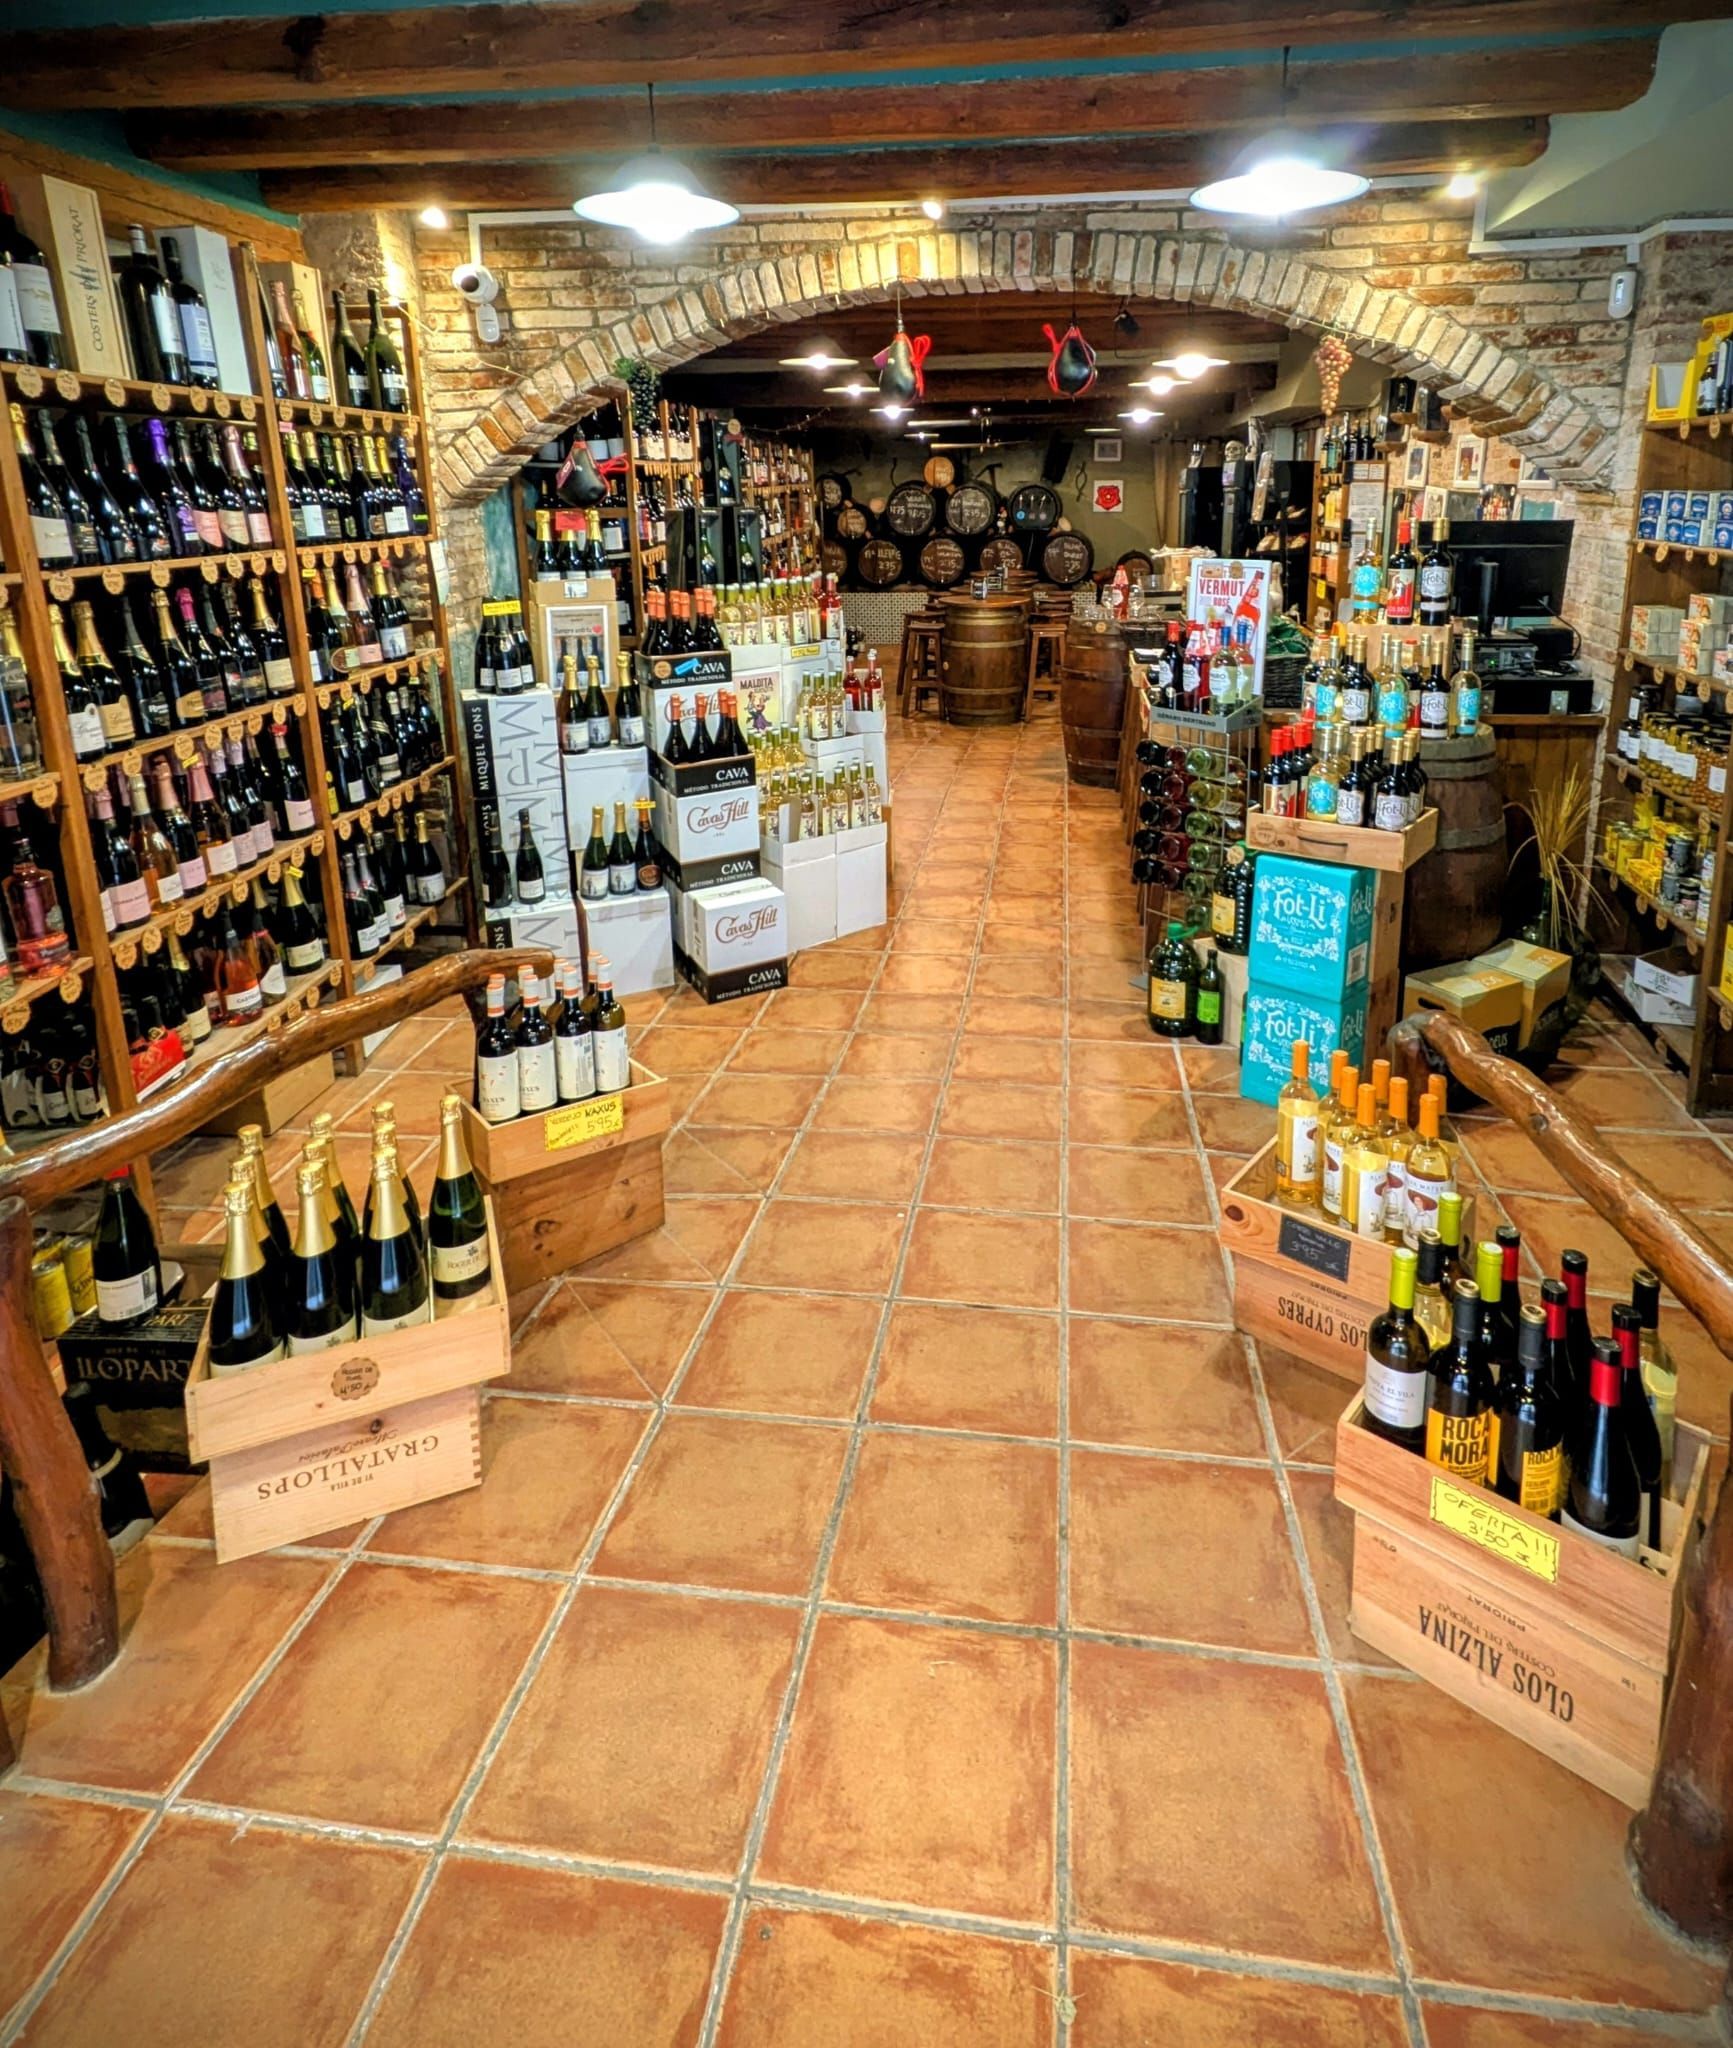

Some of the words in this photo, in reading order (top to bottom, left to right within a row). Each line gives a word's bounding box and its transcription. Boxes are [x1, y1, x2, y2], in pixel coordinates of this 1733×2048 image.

[69, 206, 88, 264] PRIORAT
[86, 293, 104, 352] COSTERS
[1199, 578, 1246, 597] VERMUT
[692, 661, 726, 675] CAVA
[740, 677, 774, 691] MALDITA
[472, 706, 483, 741] PONS
[474, 743, 490, 791] MIQUEL
[710, 778, 750, 790] TRADICIONAL
[715, 767, 749, 781] CAVA
[687, 805, 724, 835] Cavas
[722, 797, 750, 825] Hill
[721, 860, 754, 875] CAVA
[715, 913, 752, 945] Cavas
[749, 904, 779, 932] Hill
[1273, 887, 1327, 930] Fot-Li
[749, 968, 781, 985] CAVA
[1278, 1296, 1334, 1338] CYPRES
[1340, 1321, 1369, 1352] LOS
[1441, 1414, 1490, 1442] ROCA
[257, 1434, 440, 1501] GRATALLOPS
[1439, 1437, 1488, 1466] MORA
[1465, 1594, 1526, 1632] PRIORAT
[1417, 1604, 1504, 1680] ALZINA
[1506, 1640, 1557, 1679] COSTERS
[1512, 1660, 1575, 1723] CLOS
